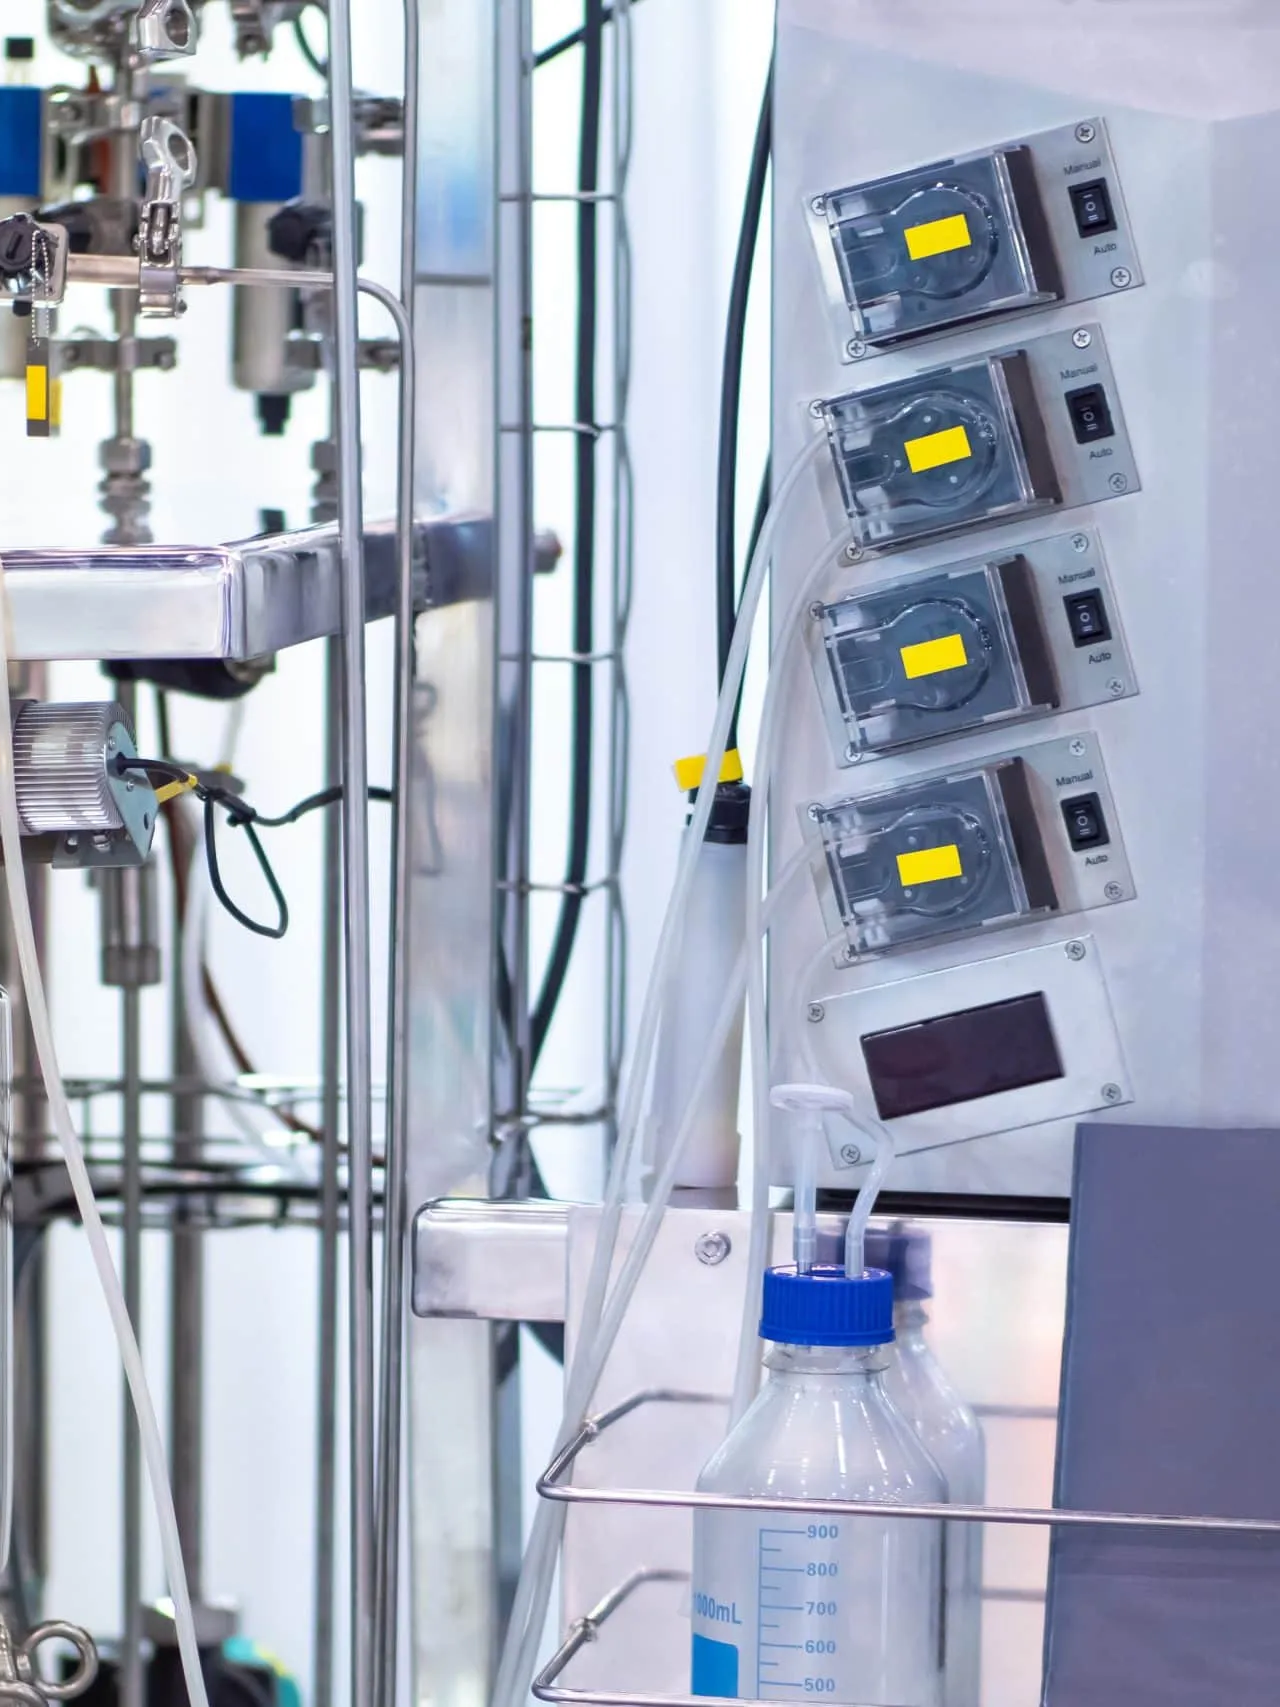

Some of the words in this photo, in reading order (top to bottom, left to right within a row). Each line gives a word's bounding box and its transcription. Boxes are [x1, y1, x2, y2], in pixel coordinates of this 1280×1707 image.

[1063, 156, 1101, 175] Manual
[1094, 243, 1117, 255] Auto
[1089, 448, 1113, 460] Auto
[1089, 653, 1111, 664] Auto
[1055, 769, 1093, 787] Manual
[1085, 855, 1108, 866] Auto
[807, 1525, 839, 1539] 900
[806, 1562, 838, 1577] 800
[806, 1601, 837, 1616] 700
[805, 1640, 836, 1654] 600
[804, 1678, 835, 1692] 500
